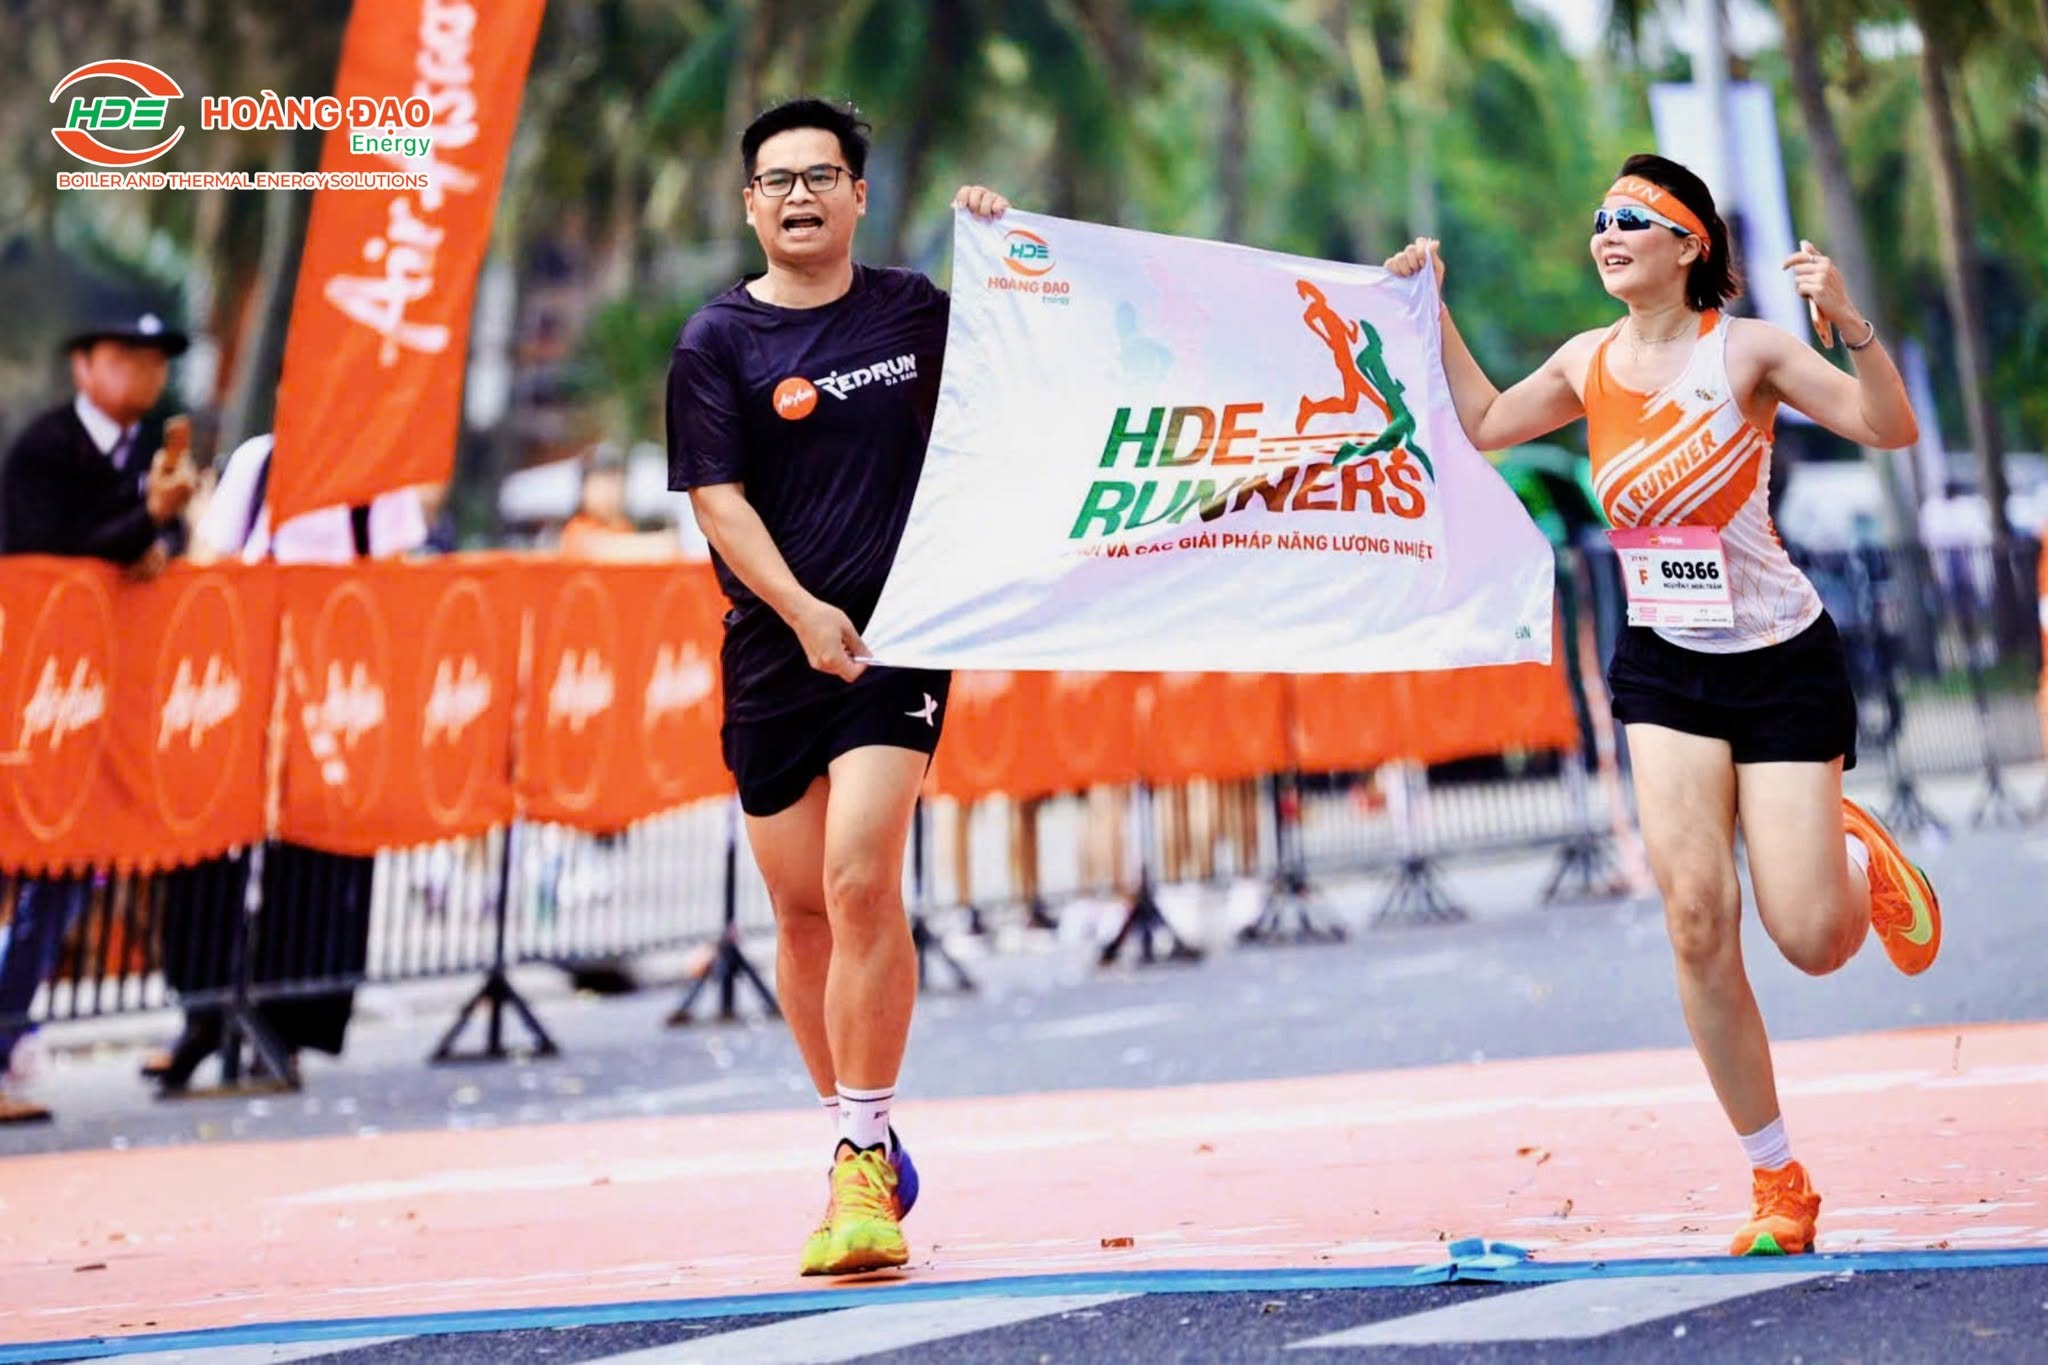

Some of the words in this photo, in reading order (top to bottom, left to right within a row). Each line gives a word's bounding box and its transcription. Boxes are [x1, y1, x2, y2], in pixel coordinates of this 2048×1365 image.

[1010, 244, 1048, 258] HDE
[1098, 402, 1263, 468] HDE
[1069, 458, 1426, 539] RUNNERS
[1222, 531, 1272, 549] PHÁP
[1278, 531, 1328, 551] NĂNG
[1332, 534, 1390, 555] LƯỢNG
[1394, 540, 1433, 562] NHIỆT
[1639, 569, 1648, 585] F
[1661, 560, 1719, 580] 60366
